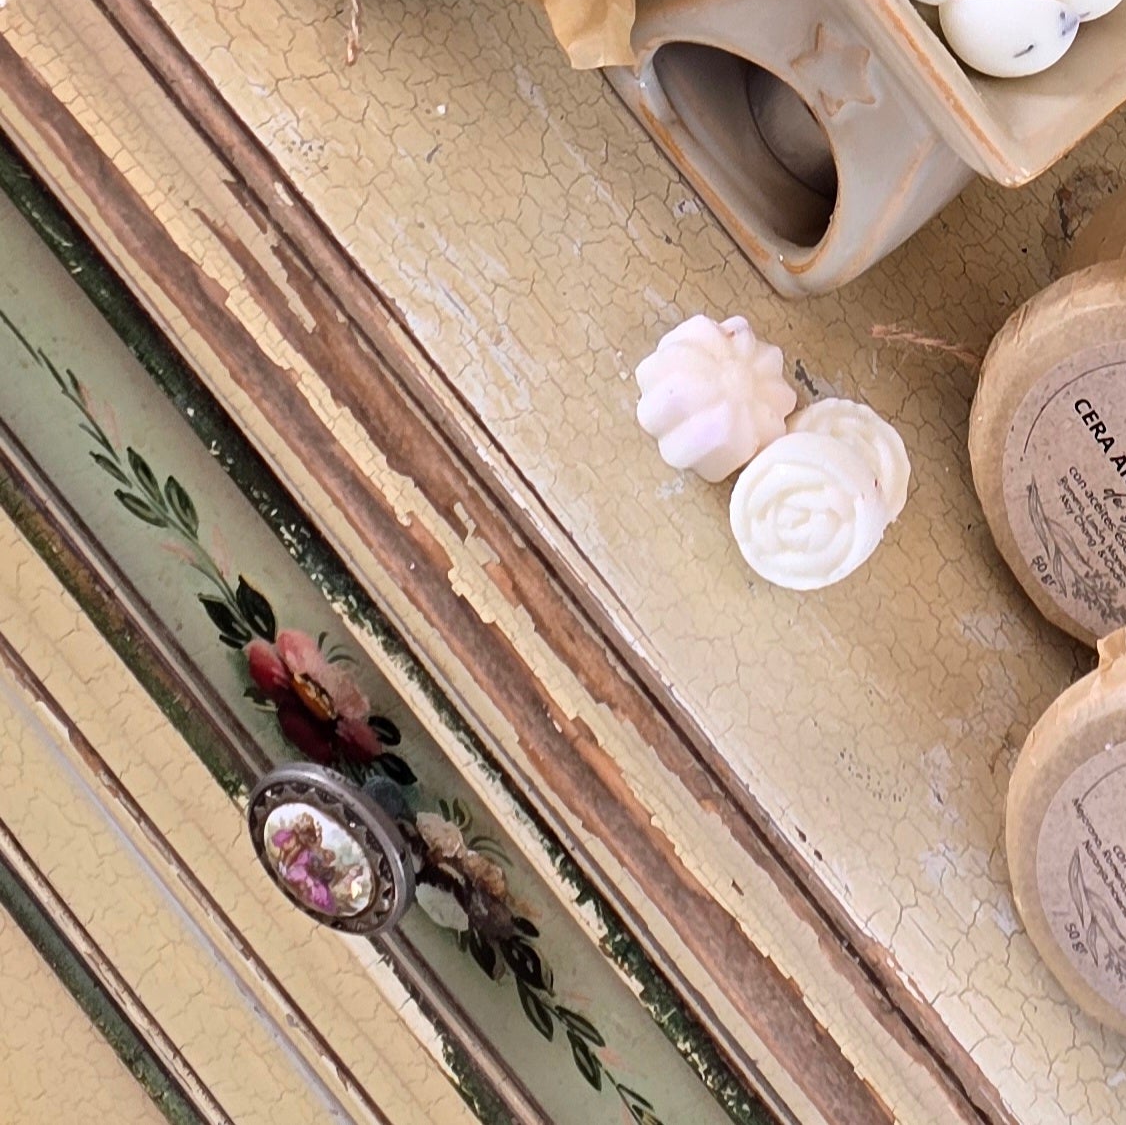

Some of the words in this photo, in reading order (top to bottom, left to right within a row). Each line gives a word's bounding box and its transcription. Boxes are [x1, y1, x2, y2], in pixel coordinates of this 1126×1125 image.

[1074, 398, 1115, 455] CERA
[1069, 466, 1087, 490] con
[1084, 489, 1121, 533] aceites
[1031, 555, 1048, 574] 50
[1040, 573, 1057, 586] gr
[1064, 922, 1081, 940] 50
[1071, 940, 1089, 955] gr
